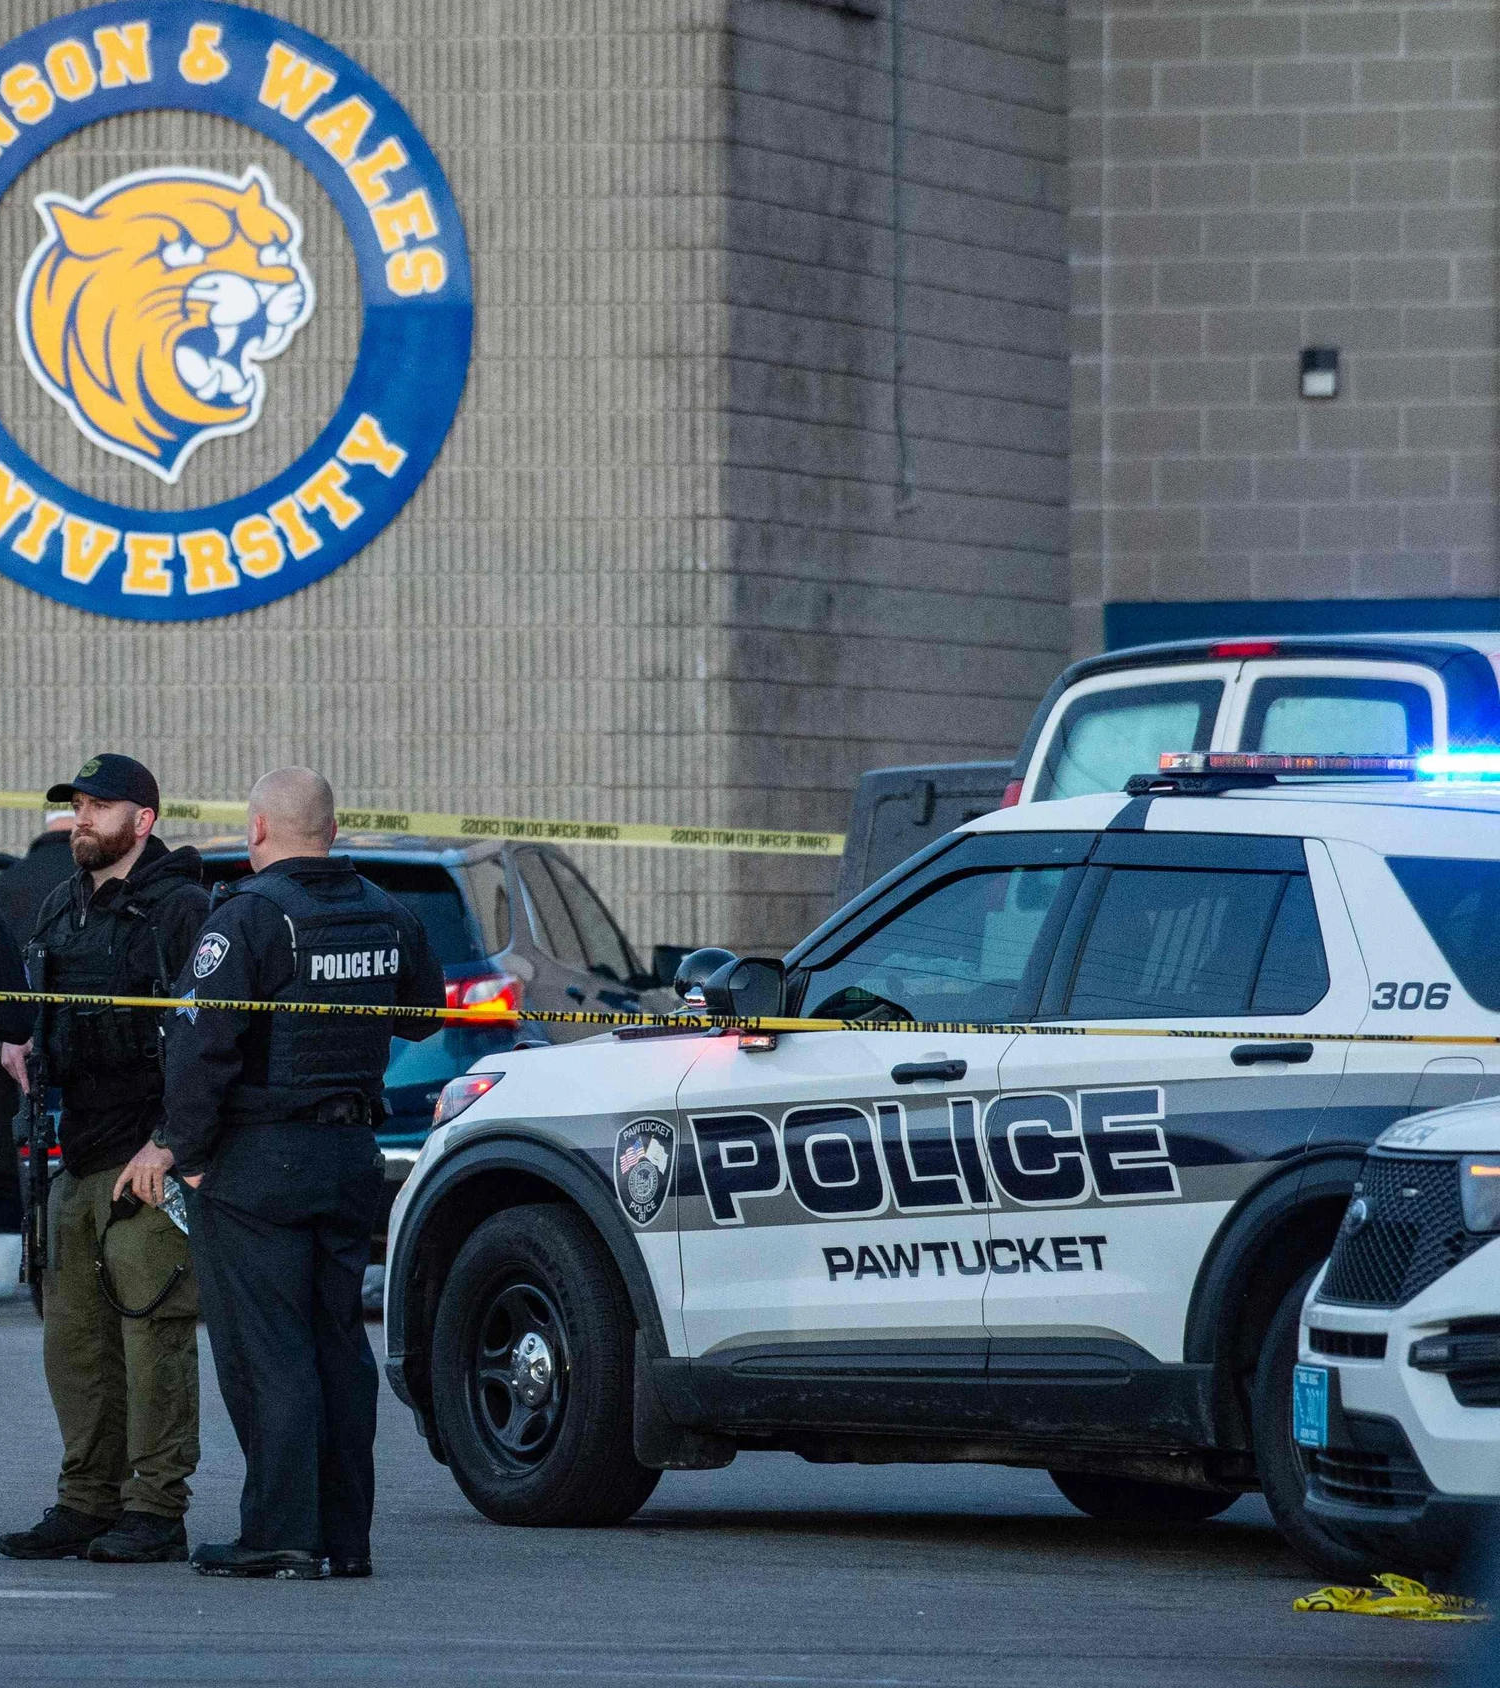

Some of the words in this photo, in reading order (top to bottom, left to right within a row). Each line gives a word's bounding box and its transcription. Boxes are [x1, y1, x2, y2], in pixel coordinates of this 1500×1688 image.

[178, 21, 230, 86] &
[258, 41, 449, 299] WALES
[311, 952, 371, 980] POLICE
[373, 948, 399, 976] K-9
[1371, 982, 1451, 1010] 306
[623, 1122, 671, 1141] PAWTUCKET
[687, 1085, 1182, 1225] POLICE
[629, 1200, 657, 1214] POLICE
[638, 1213, 646, 1222] RI
[822, 1235, 1108, 1281] PAWTUCKET
